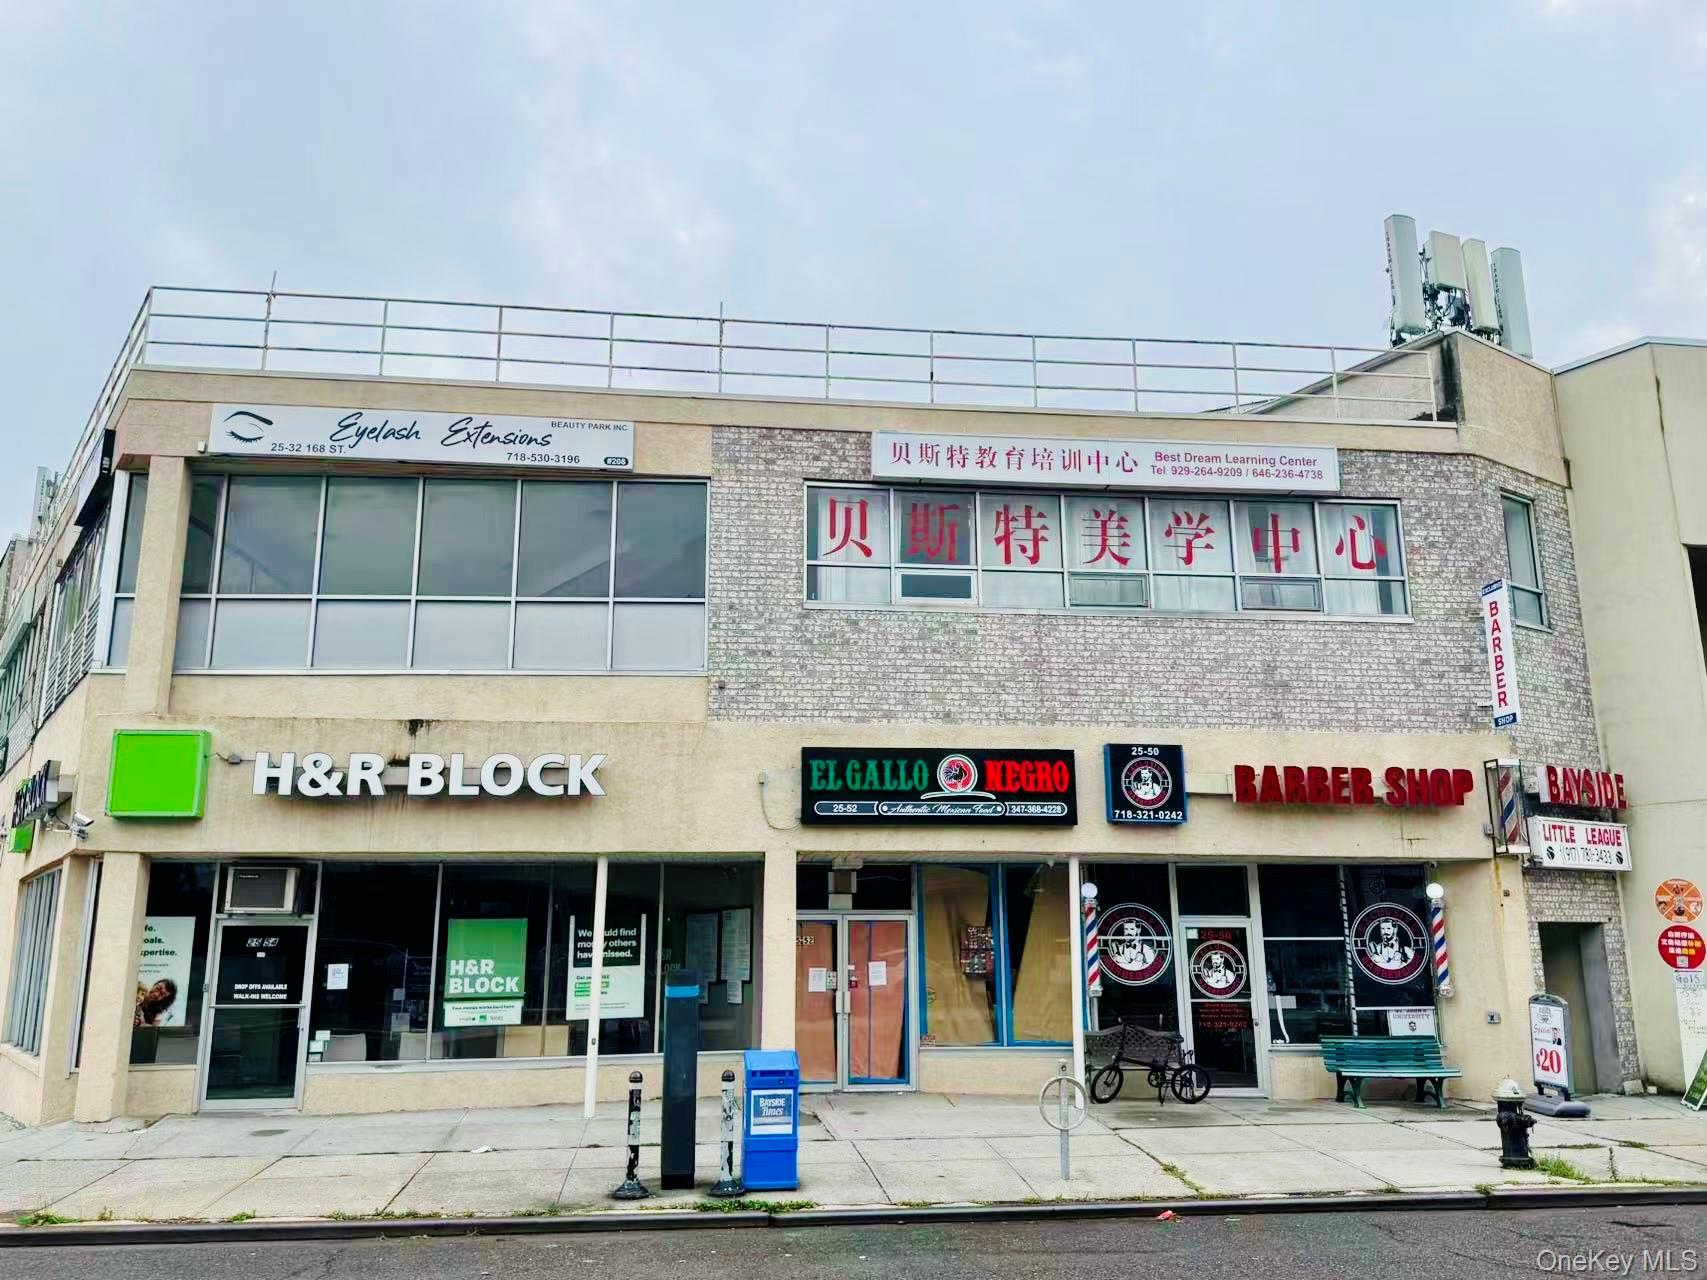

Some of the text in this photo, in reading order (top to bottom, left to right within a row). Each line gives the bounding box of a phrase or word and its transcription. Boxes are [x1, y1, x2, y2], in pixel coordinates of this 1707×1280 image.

[329, 411, 553, 449] Eyelash Extensions
[551, 420, 586, 430] BEAUTY
[588, 423, 611, 431] PARK
[271, 443, 346, 454] 25-32 168 ST.
[506, 452, 580, 464] 718-530-3196
[889, 441, 1139, 475] 贝斯特教育培训中心
[1155, 452, 1317, 467] Best Dream Learning Center
[1151, 465, 1166, 475] Tel
[1171, 467, 1242, 477] 929-264-9209
[1252, 468, 1323, 479] 646-236-4738
[822, 497, 1387, 574] 贝斯特美学中心
[1489, 600, 1508, 708] BARBER
[1497, 715, 1514, 726] SHOP
[1131, 747, 1159, 756] 25-50
[252, 752, 608, 796] H&R BLOCK
[809, 760, 1070, 792] EL GALLO NEGRO
[1234, 765, 1474, 806] BARBER SHOP
[1545, 765, 1628, 809] BAYSIDE
[832, 803, 1062, 814] 25-52 Authentic Mexican Food 347-368-4228
[1114, 810, 1183, 820] 718-321-0242
[1543, 824, 1622, 846] LITTLE LEAGUE
[144, 924, 156, 932] fe.
[577, 929, 592, 937] We
[619, 928, 637, 936] find
[795, 936, 815, 945] 5-52
[1201, 930, 1232, 940] 25-50
[577, 939, 637, 949] moy others
[140, 948, 177, 957] xpertise.
[577, 951, 592, 959] hav
[449, 959, 494, 976] H&R
[448, 976, 520, 994] BLOCK
[1535, 1048, 1561, 1074] $20
[760, 1097, 785, 1107] BAYSIDE
[761, 1106, 784, 1116] Times
